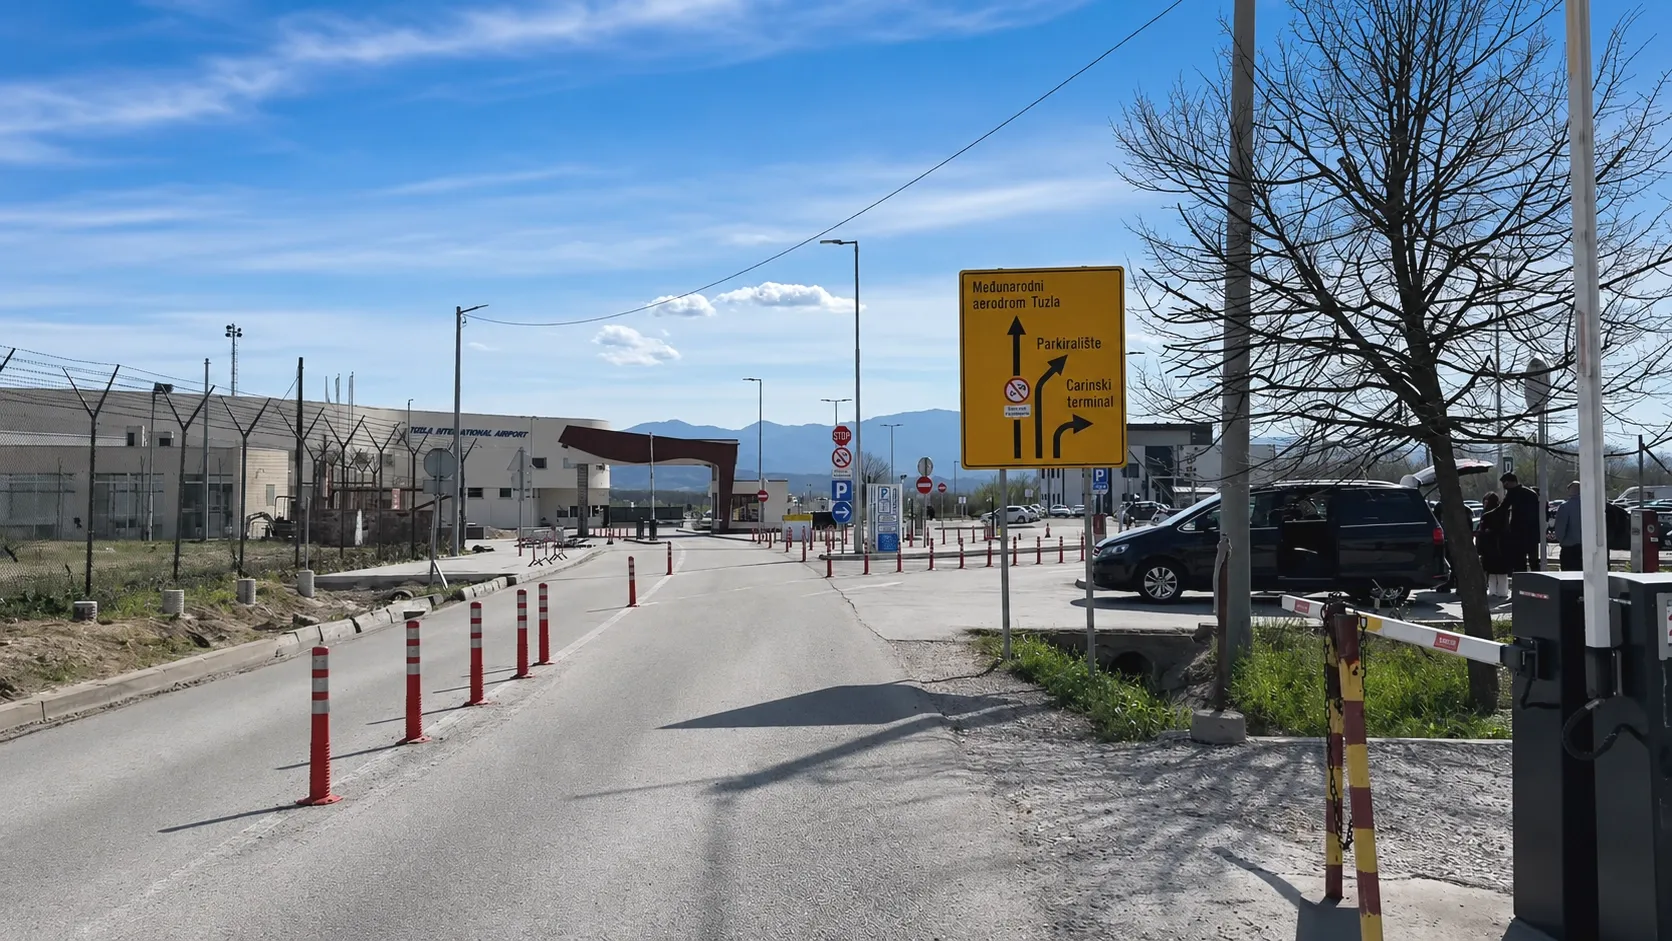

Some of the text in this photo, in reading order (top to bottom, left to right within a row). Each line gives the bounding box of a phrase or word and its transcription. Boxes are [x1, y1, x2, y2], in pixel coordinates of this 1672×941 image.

[973, 280, 1044, 293] Međunarodni
[973, 295, 1060, 310] aerodrom Tuzla
[1037, 337, 1102, 350] Parkiralište
[1066, 378, 1112, 391] Carinski
[1067, 395, 1114, 408] terminal
[494, 430, 529, 438] AIRPORT
[833, 431, 851, 441] STOP
[1095, 468, 1104, 482] P
[836, 482, 848, 499] P
